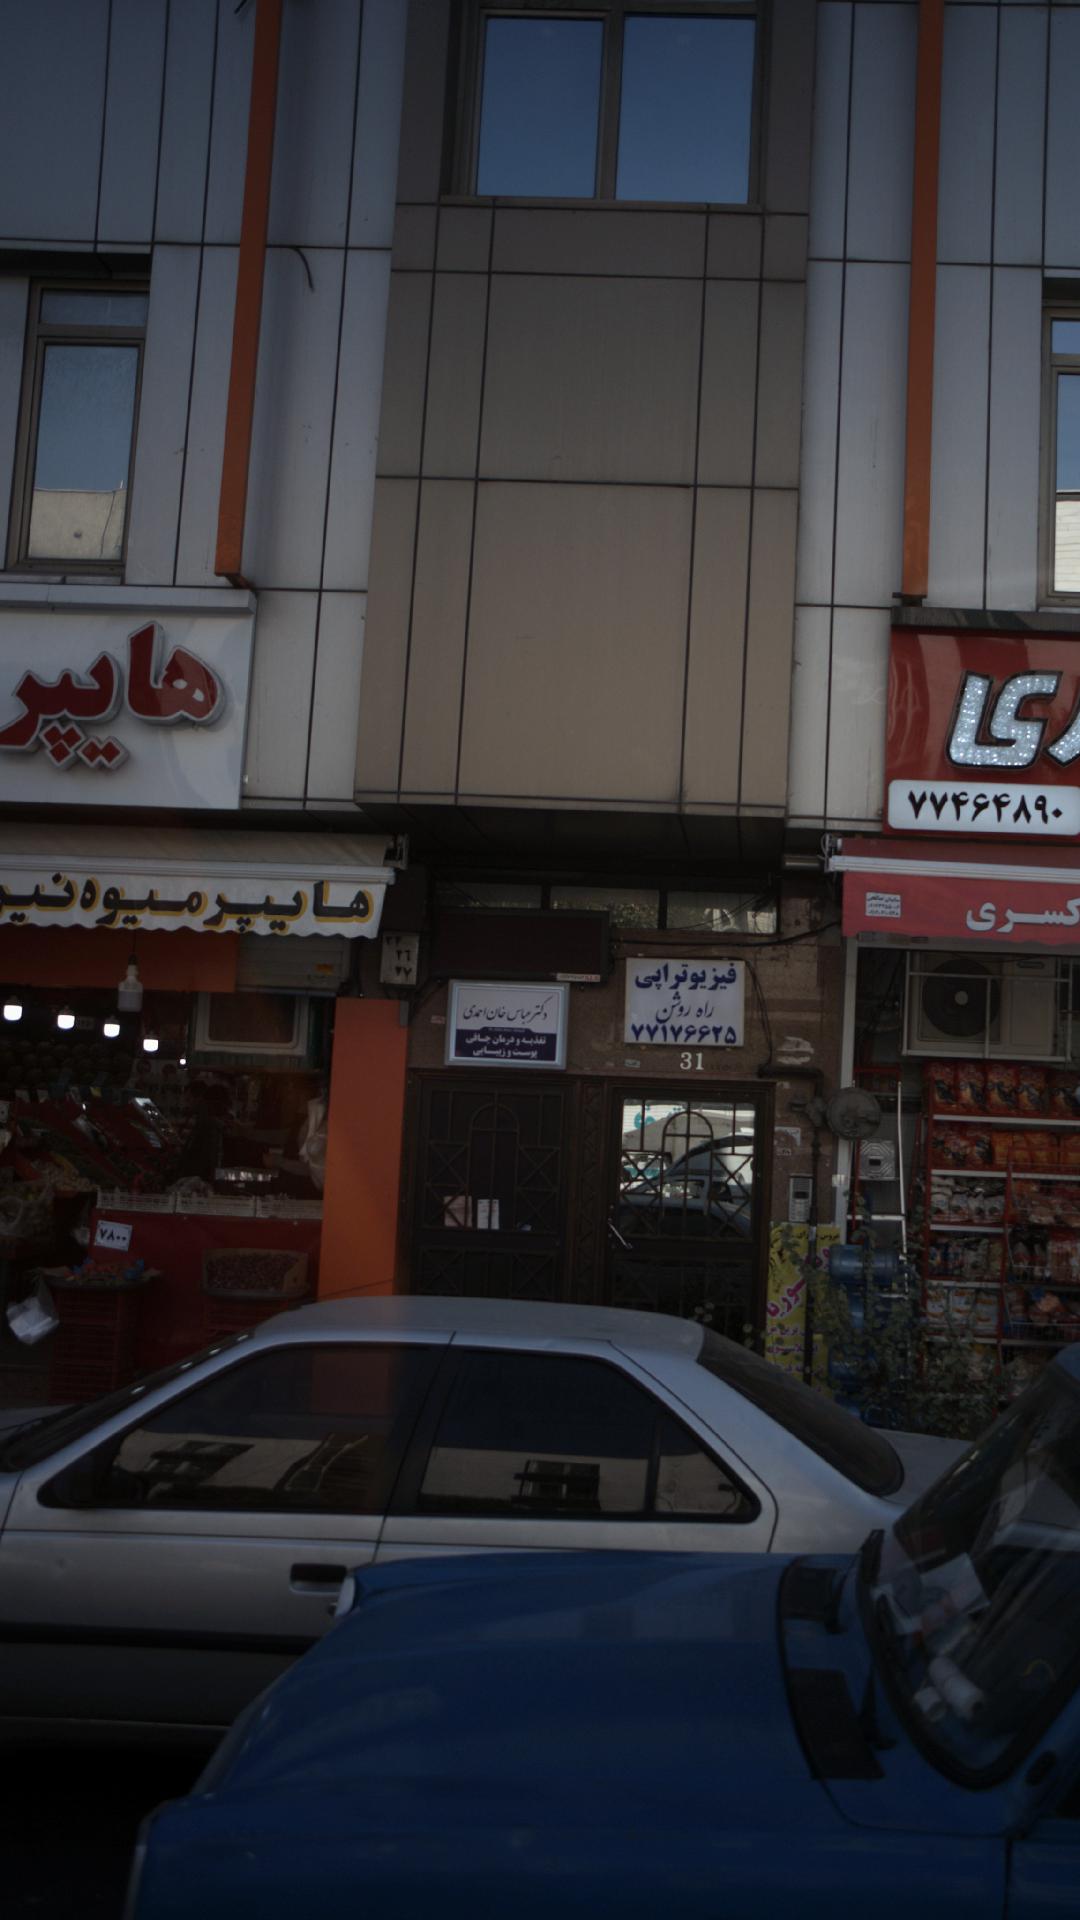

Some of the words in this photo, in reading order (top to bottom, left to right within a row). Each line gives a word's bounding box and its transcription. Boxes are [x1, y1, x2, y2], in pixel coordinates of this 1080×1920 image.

[0, 621, 223, 768] هایپر
[907, 790, 1063, 824] ۷۷۴۶۴۸۹۰
[80, 878, 206, 926] میوه
[203, 880, 373, 933] هایپر
[635, 962, 737, 990] فیزیوتراپی
[463, 1004, 486, 1020] احمدی
[507, 1006, 531, 1024] عباس
[525, 995, 553, 1024] دکتر
[655, 991, 692, 1024] روشن
[696, 1000, 714, 1018] راه
[492, 1033, 516, 1046] درمان
[521, 1034, 547, 1046] تغذیه
[631, 1023, 737, 1044] ۷۷۱۷۶۶۲۵
[472, 1044, 507, 1058] زیبایی
[512, 1047, 538, 1059] پوست
[680, 1052, 704, 1070] 31
